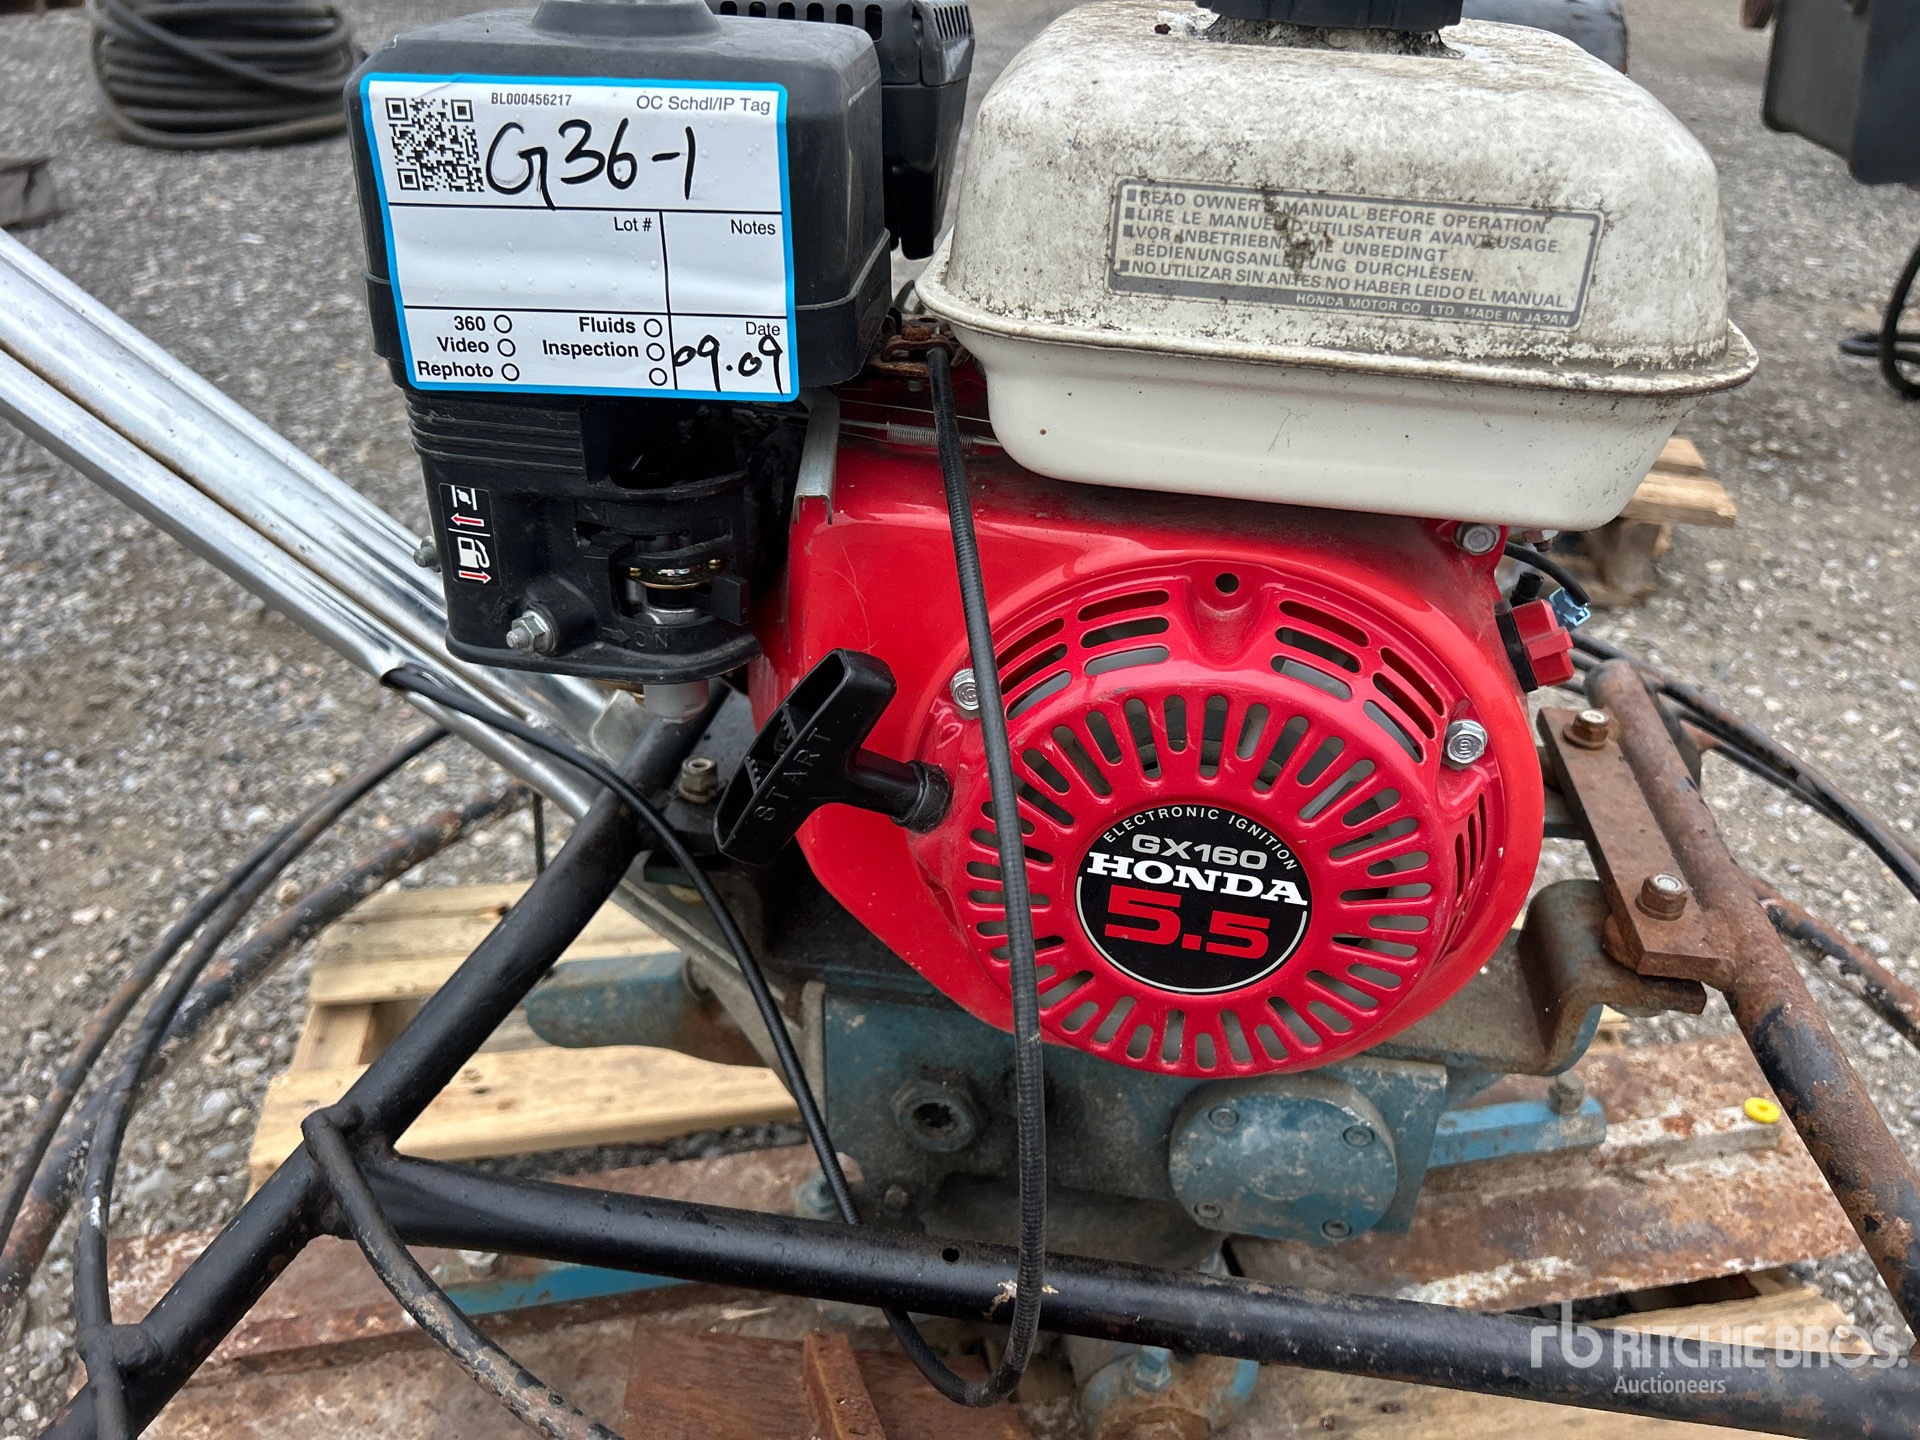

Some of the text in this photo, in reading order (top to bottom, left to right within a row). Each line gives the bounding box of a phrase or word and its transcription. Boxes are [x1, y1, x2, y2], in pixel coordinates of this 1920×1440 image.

[490, 92, 573, 107] BL000456217
[636, 95, 771, 115] OC Schdl/IP Tag
[1140, 190, 1550, 234] READ OWNER' MANUAL BEFORE OPERATION.
[613, 217, 653, 232] Lot #
[730, 219, 776, 236] Notes
[1137, 208, 1175, 223] LIRE
[1182, 211, 1202, 225] LE
[1209, 213, 1285, 231] MANUE
[1429, 231, 1490, 248] AVANT
[1498, 236, 1561, 253] USAGE.
[1136, 226, 1448, 263] VOR INBETRIEBNAME UNBEDINGT
[1132, 260, 1156, 275] NO
[1160, 262, 1231, 282] UTILIZAR
[1236, 269, 1264, 284] SIN
[1266, 271, 1322, 288] ANTES
[1325, 277, 1351, 291] NO
[1354, 279, 1411, 296] HABER
[1415, 284, 1465, 300] LEIDO
[1469, 288, 1487, 302] EL
[1355, 260, 1477, 284] DURCHLESEN.
[1296, 293, 1344, 307] HONDA
[1348, 297, 1398, 311] MOTOR
[1463, 307, 1503, 320] MADE
[1506, 310, 1522, 322] IN
[1524, 313, 1570, 326] JAPAN
[453, 316, 486, 332] 360
[578, 316, 636, 334] Fluids
[745, 321, 781, 336] Date
[436, 336, 490, 354] Video
[542, 341, 640, 362] Inspection
[417, 361, 494, 382] Rephoto
[754, 726, 832, 822] START
[1103, 806, 1298, 871] ELECTRONIC IGNITION
[1131, 833, 1268, 870] GX160
[1086, 851, 1308, 906] HONDA
[1104, 884, 1271, 959] 5.5
